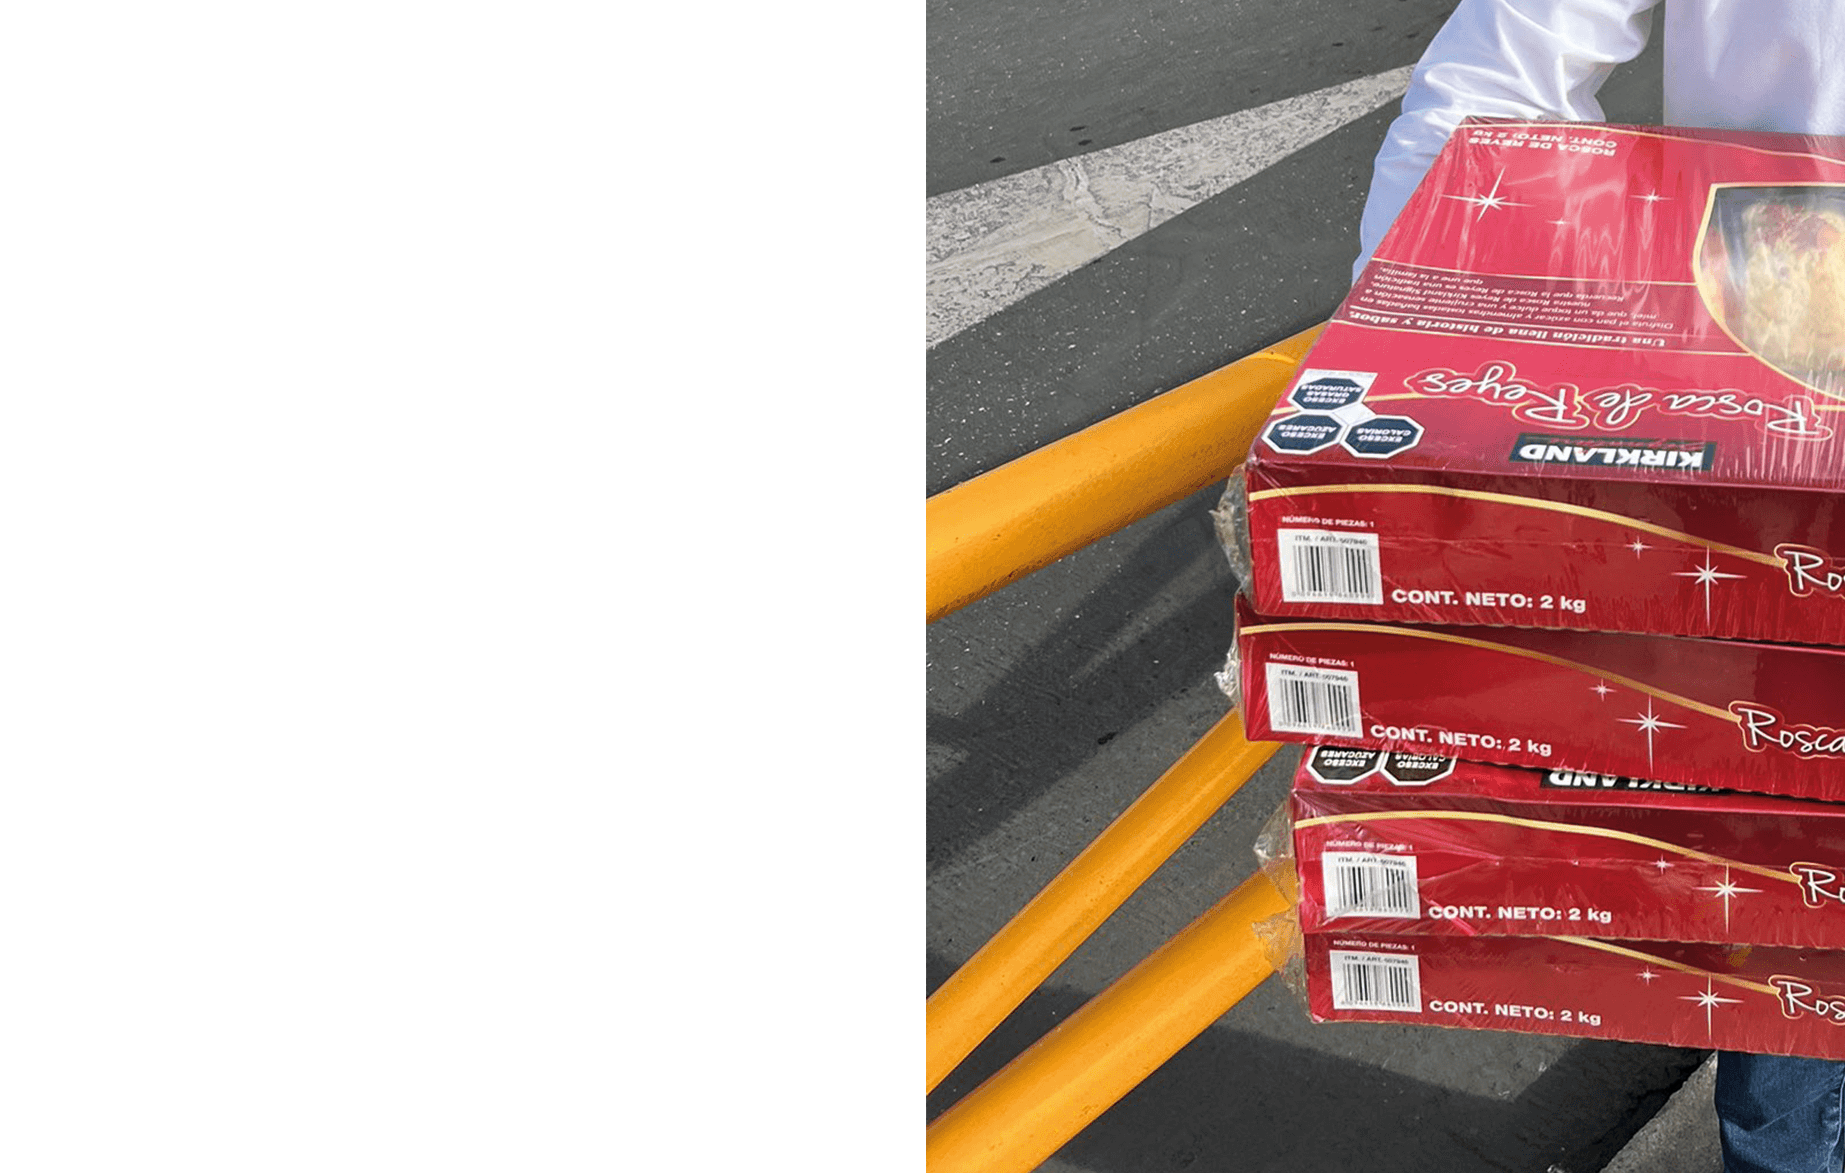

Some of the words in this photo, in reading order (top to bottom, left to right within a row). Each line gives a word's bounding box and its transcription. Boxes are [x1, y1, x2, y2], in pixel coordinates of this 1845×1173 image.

[1468, 137, 1524, 147] REYES
[1514, 133, 1563, 142] NETO:
[1569, 136, 1617, 147] CONT.
[1529, 141, 1552, 149] DE
[1558, 144, 1616, 157] ROSCA
[1348, 311, 1398, 326] sabor.
[1402, 318, 1413, 326] y
[1416, 319, 1479, 334] historia
[1484, 326, 1504, 336] de
[1509, 328, 1547, 338] llena
[1553, 331, 1626, 344] tradición
[1632, 337, 1666, 347] Una
[1304, 396, 1346, 404] EXCESO
[1422, 365, 1580, 425] Reyes
[1595, 388, 1652, 428] de
[1663, 391, 1823, 436] Rosca
[1278, 424, 1336, 433] AZÚCARES
[1357, 428, 1411, 436] CALORÍAS
[1281, 431, 1326, 439] EXCESO
[1519, 443, 1704, 468] KIRKLAND
[1392, 589, 1461, 607] CONT.
[1468, 590, 1535, 609] NETO:
[1540, 594, 1554, 609] 2
[1560, 595, 1587, 614] kg
[1371, 724, 1431, 745] CONT.
[1439, 730, 1503, 750] NETO:
[1509, 738, 1522, 752] 2
[1527, 740, 1552, 757] kg
[1324, 758, 1366, 767] EXCESO
[1397, 761, 1439, 769] EXCESO
[1428, 905, 1491, 920] CONT.
[1498, 907, 1562, 921] NETO:
[1568, 907, 1581, 921] 2
[1587, 908, 1612, 924] kg
[1429, 999, 1489, 1015] CONT.
[1495, 1005, 1554, 1021] NETO:
[1560, 1009, 1573, 1022] 2
[1577, 1010, 1601, 1026] kg
